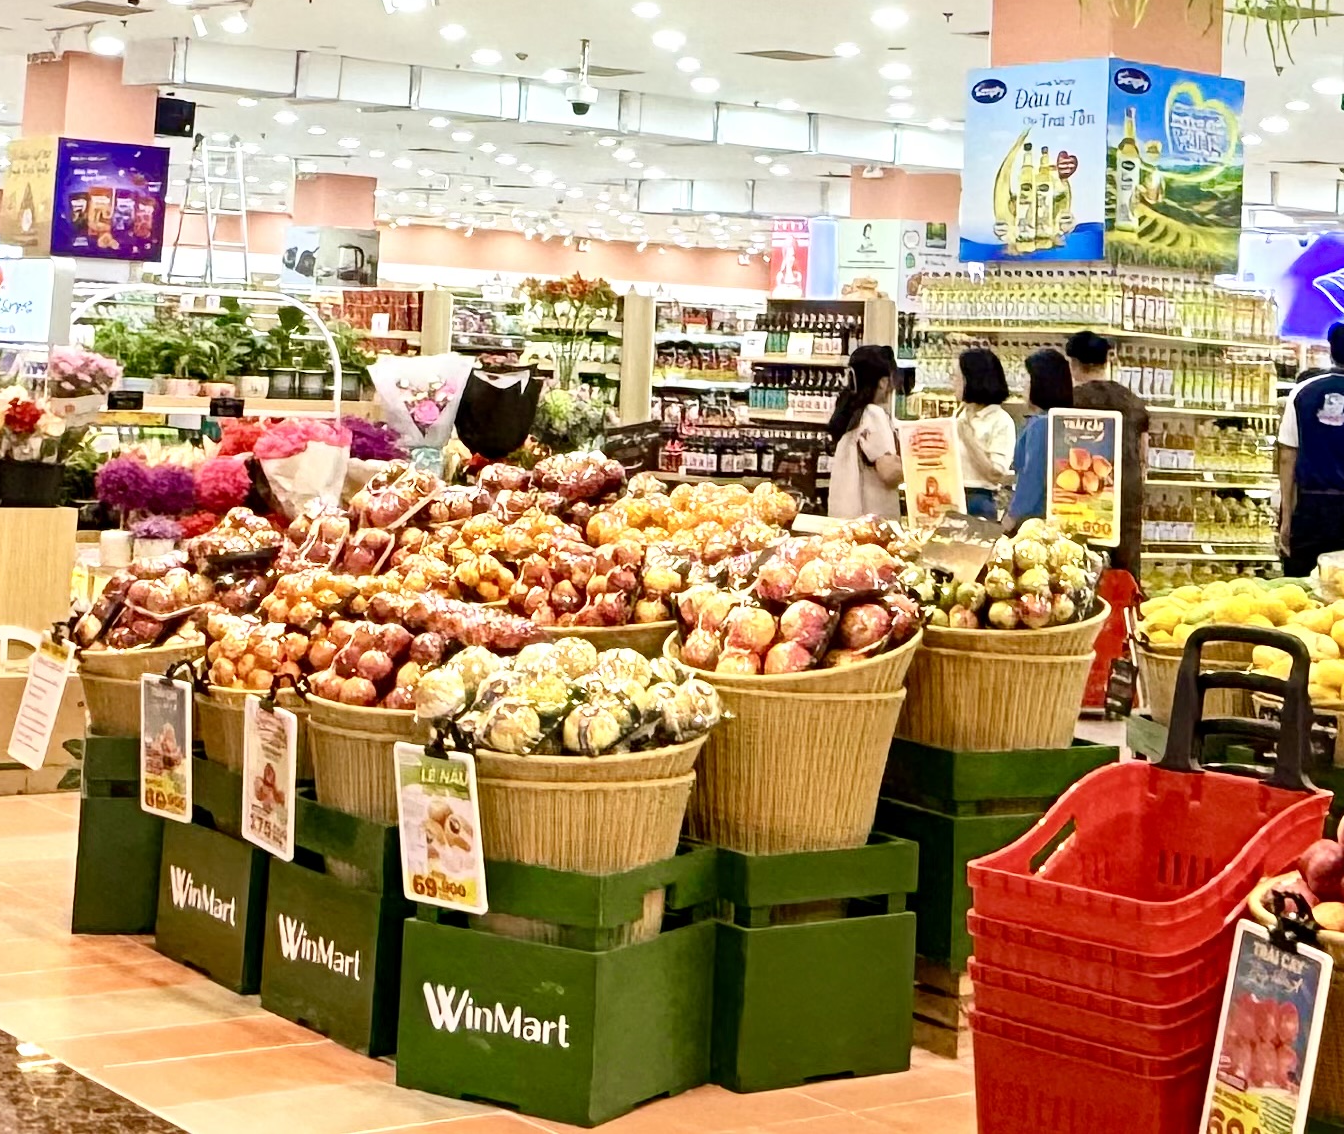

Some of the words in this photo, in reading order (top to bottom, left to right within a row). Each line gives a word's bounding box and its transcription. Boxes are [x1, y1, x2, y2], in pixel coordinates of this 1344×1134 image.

[170, 865, 236, 928] WinMart
[278, 913, 361, 981] WinMart
[423, 982, 571, 1048] WinMart
